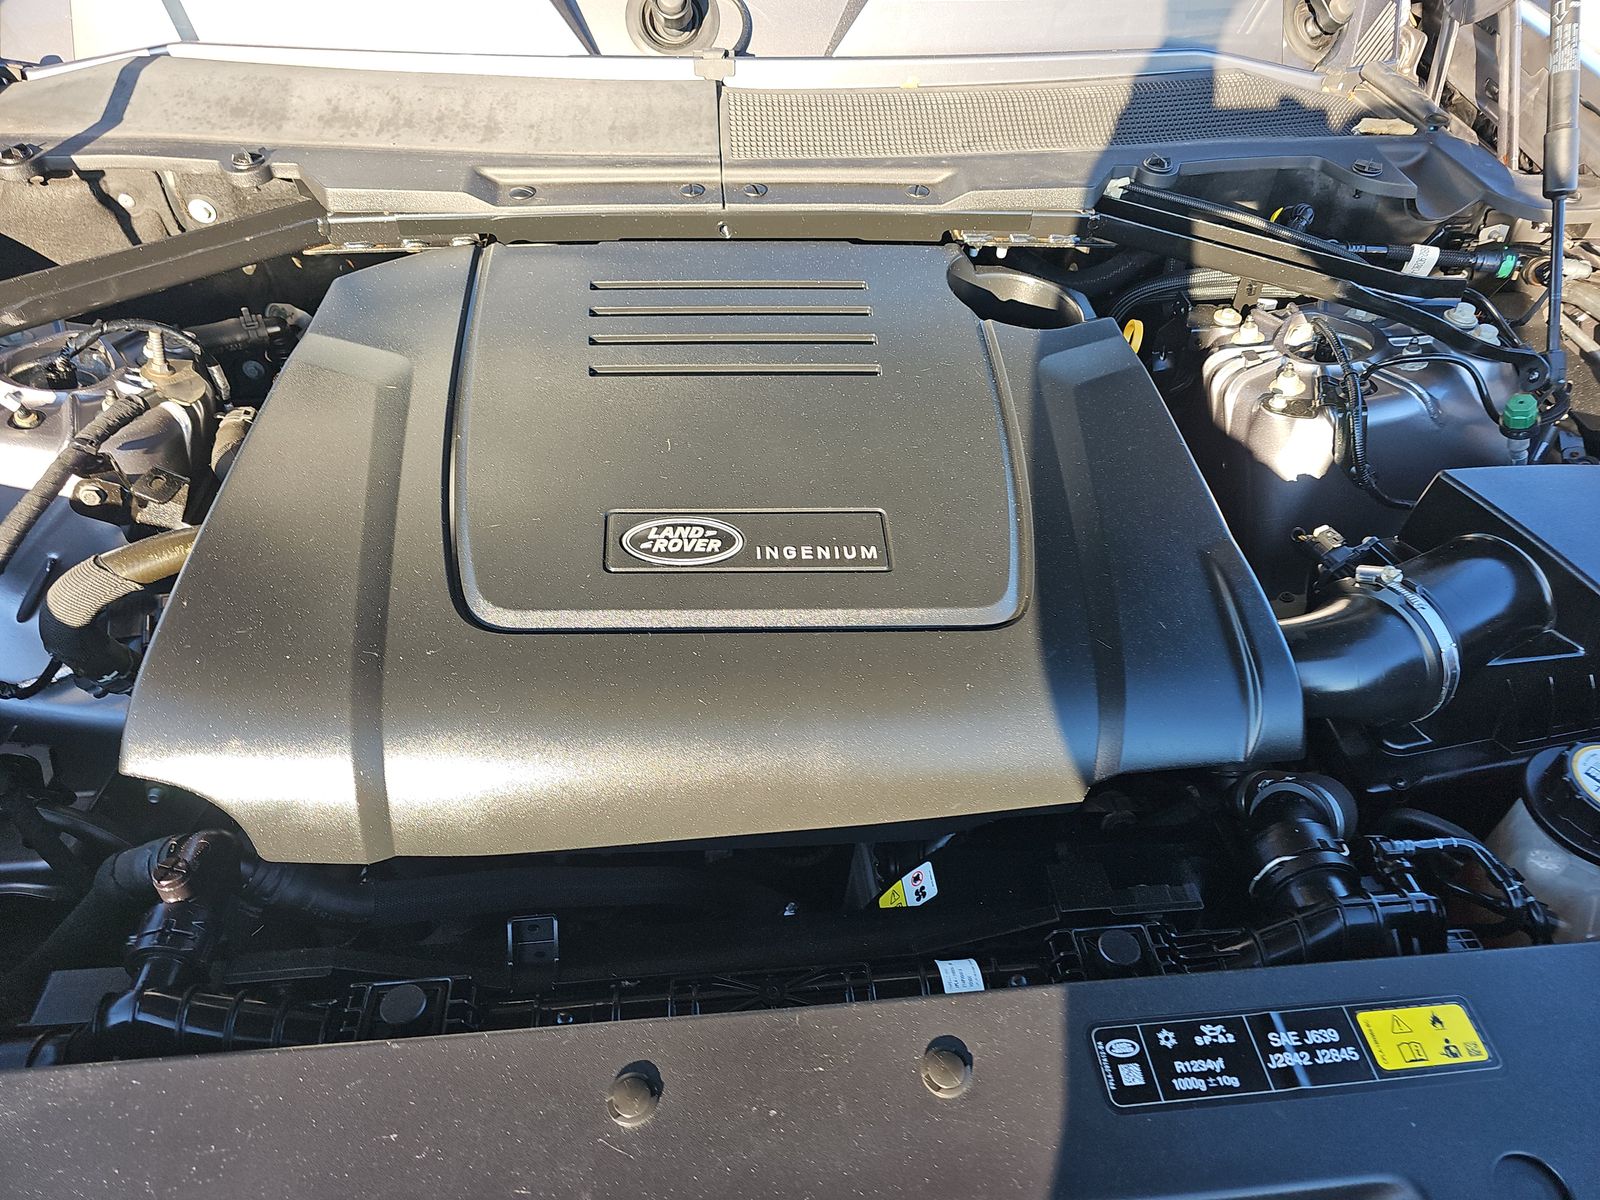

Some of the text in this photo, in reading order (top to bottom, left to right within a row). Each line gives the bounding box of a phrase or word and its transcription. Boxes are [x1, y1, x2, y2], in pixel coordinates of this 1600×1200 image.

[647, 526, 705, 539] LAND
[652, 538, 722, 552] ROVER
[756, 546, 878, 560] INGENIUM
[1194, 1033, 1236, 1046] SP-A2
[1267, 1028, 1340, 1047] SAE J639
[1267, 1046, 1360, 1069] J2842 J2845
[1174, 1057, 1226, 1073] R1234yf
[1172, 1076, 1207, 1091] 1000g
